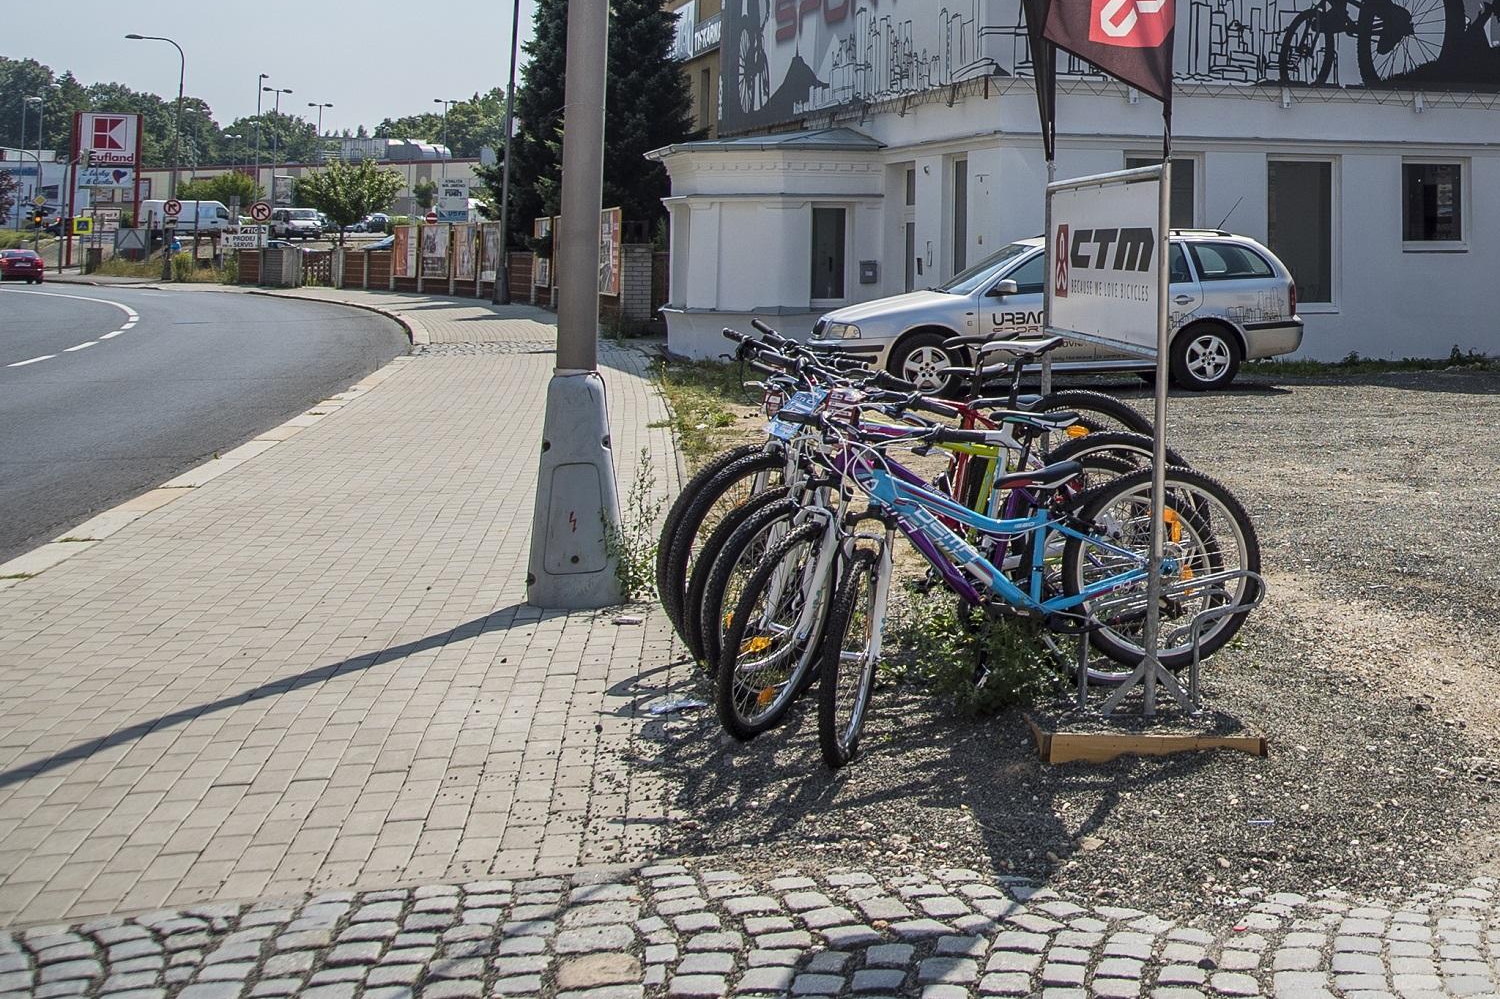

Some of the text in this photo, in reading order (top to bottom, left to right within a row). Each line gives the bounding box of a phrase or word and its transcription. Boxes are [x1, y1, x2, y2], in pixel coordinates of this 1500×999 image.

[1070, 227, 1154, 273] CTM
[1071, 279, 1092, 295] BECAUSE
[1104, 282, 1118, 298] LOVE
[1120, 283, 1149, 302] BICYCLES
